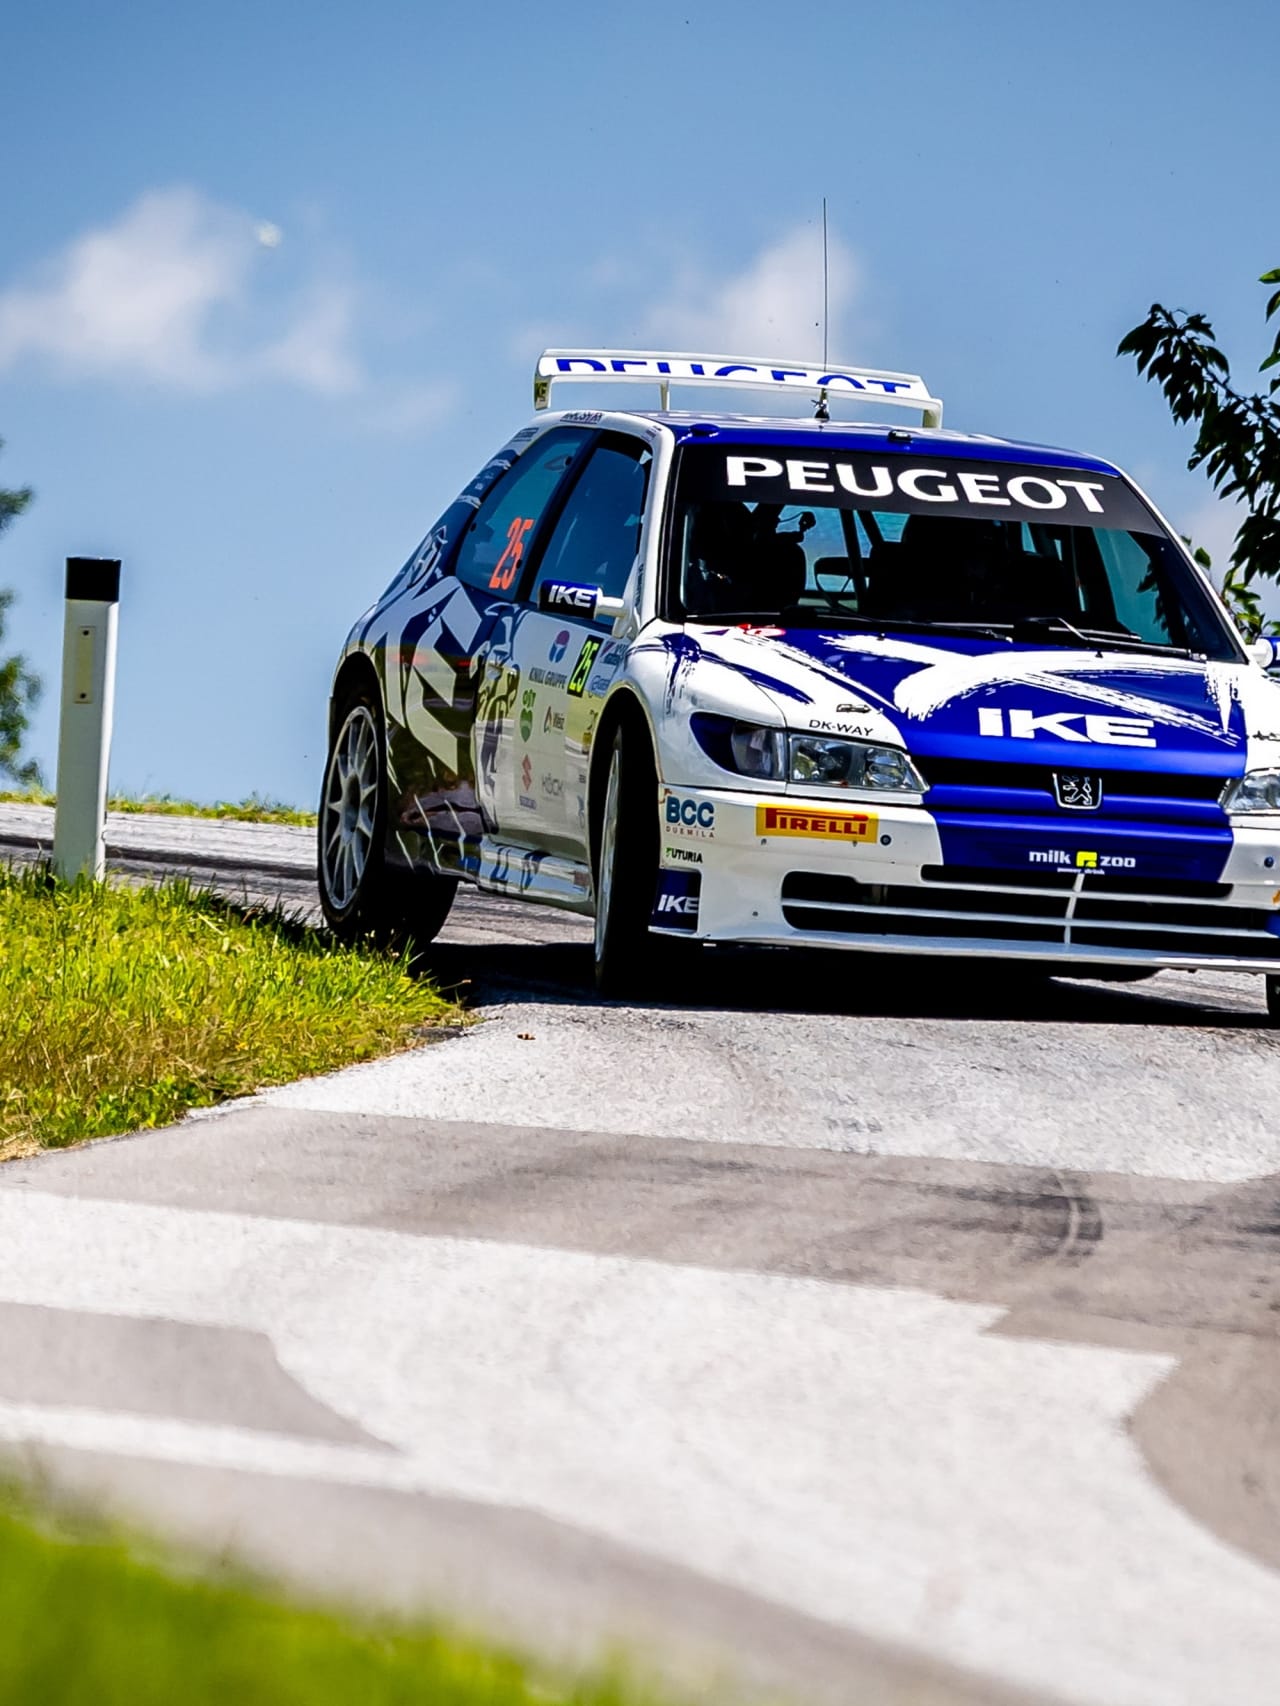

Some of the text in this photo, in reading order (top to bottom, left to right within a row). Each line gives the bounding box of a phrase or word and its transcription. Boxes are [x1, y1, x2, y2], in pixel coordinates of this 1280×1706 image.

[726, 455, 1105, 513] PEUGEOT
[488, 516, 535, 591] 25
[548, 584, 598, 608] IKE
[568, 640, 600, 693] 25
[808, 719, 874, 737] DK-WAY
[978, 707, 1157, 748] IKE
[666, 796, 715, 828] BCC
[765, 807, 869, 836] PIRELLI
[665, 825, 715, 838] DUEMILA
[666, 847, 703, 864] FUTURIA
[1029, 850, 1071, 865] milk
[657, 893, 699, 914] IKE
